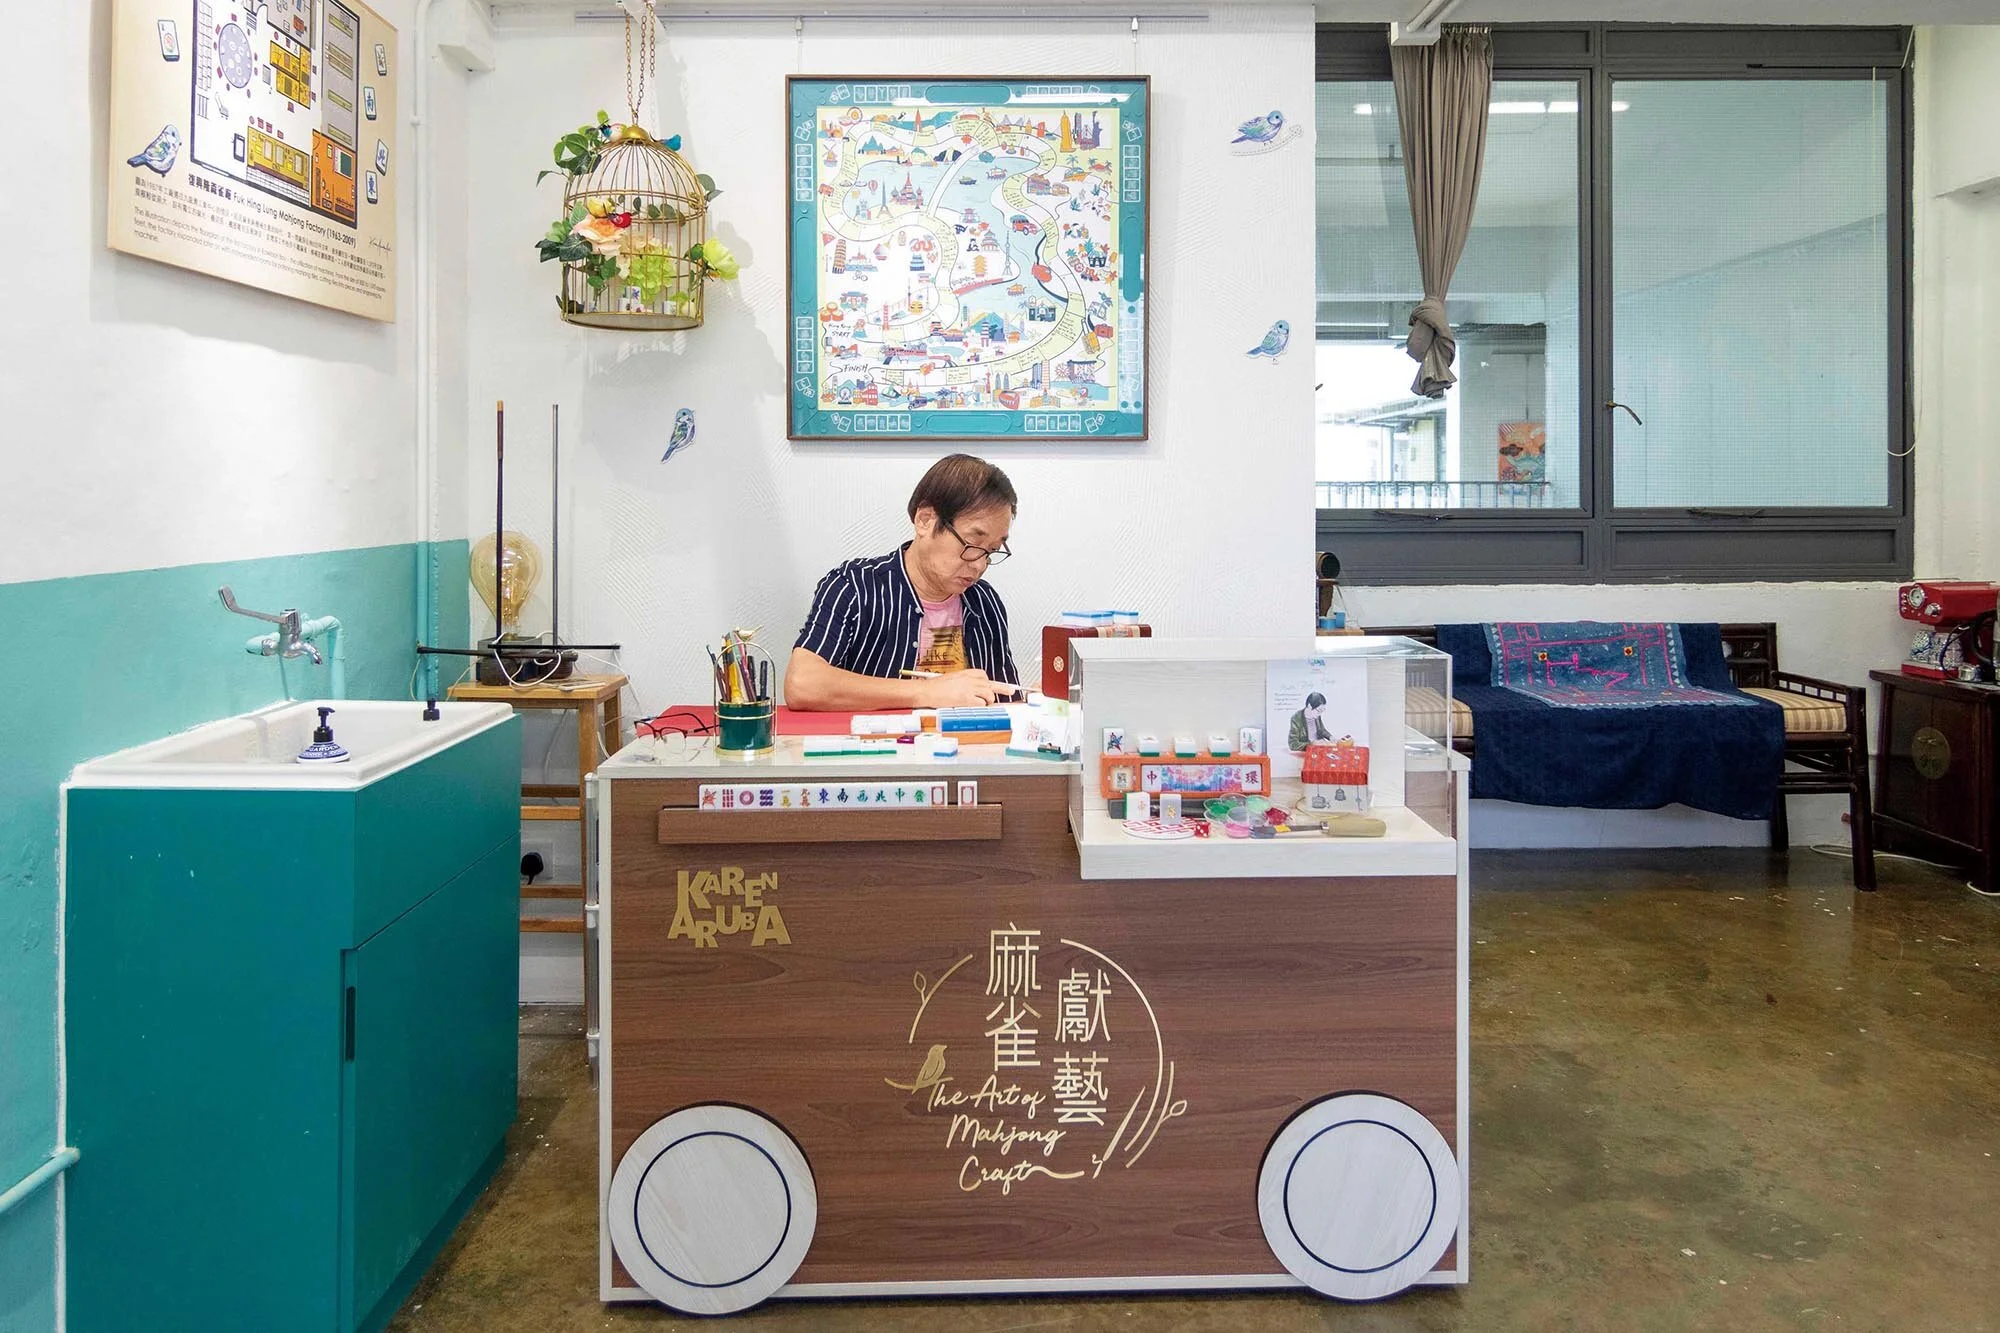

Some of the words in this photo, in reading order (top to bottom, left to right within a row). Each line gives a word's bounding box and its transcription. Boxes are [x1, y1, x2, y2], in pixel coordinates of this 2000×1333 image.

[234, 192, 245, 204] Fuk
[247, 197, 261, 213] Hing
[263, 204, 278, 219] Lung
[279, 210, 305, 230] Mahjong
[306, 220, 326, 237] Factory
[844, 363, 869, 373] FINISH
[818, 787, 829, 804] 東
[837, 787, 848, 803] 南
[856, 789, 868, 803] 西
[875, 789, 887, 803] 北
[895, 787, 905, 803] 中
[1147, 770, 1158, 785] 中
[677, 866, 778, 909] KAREN
[667, 905, 792, 948] ARUBA
[984, 921, 1041, 1072] 麻雀
[928, 1076, 969, 1112] The
[970, 1074, 1020, 1112] Art
[1020, 1090, 1046, 1119] of
[946, 1114, 1067, 1156] Mahjong
[958, 1155, 1060, 1196] Craft
